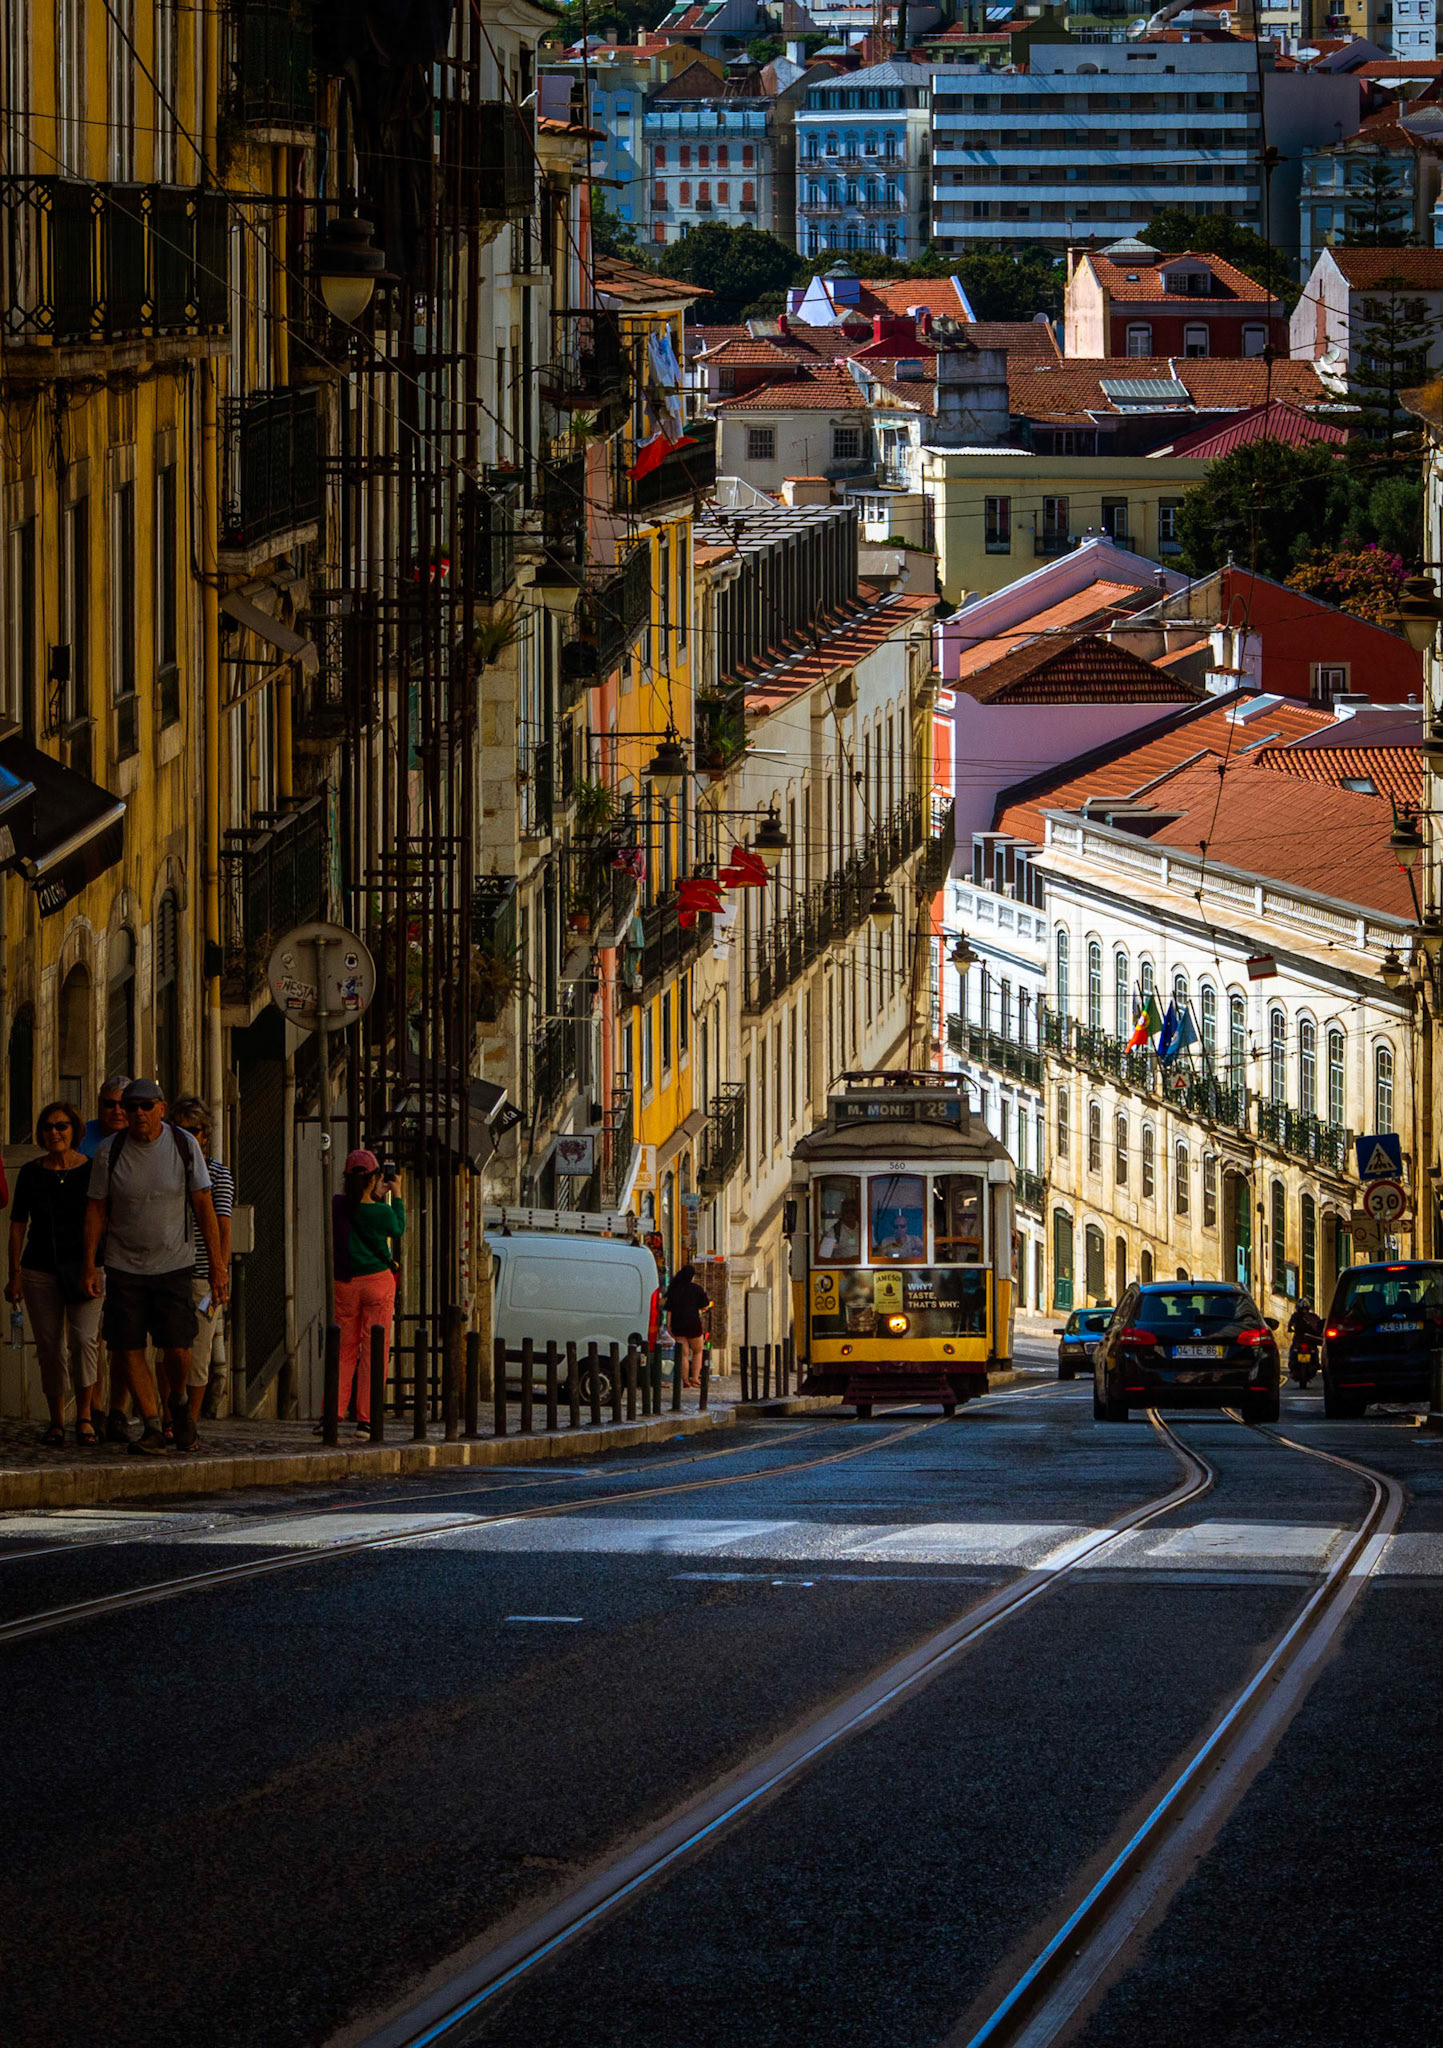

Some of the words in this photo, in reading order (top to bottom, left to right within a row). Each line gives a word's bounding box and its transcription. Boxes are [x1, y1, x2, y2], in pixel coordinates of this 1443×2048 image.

[847, 1105, 863, 1115] M.
[867, 1104, 912, 1115] MONIZ
[927, 1101, 947, 1117] 28
[889, 1162, 905, 1170] 560
[1372, 1194, 1399, 1211] 30
[908, 1283, 933, 1291] WHY?
